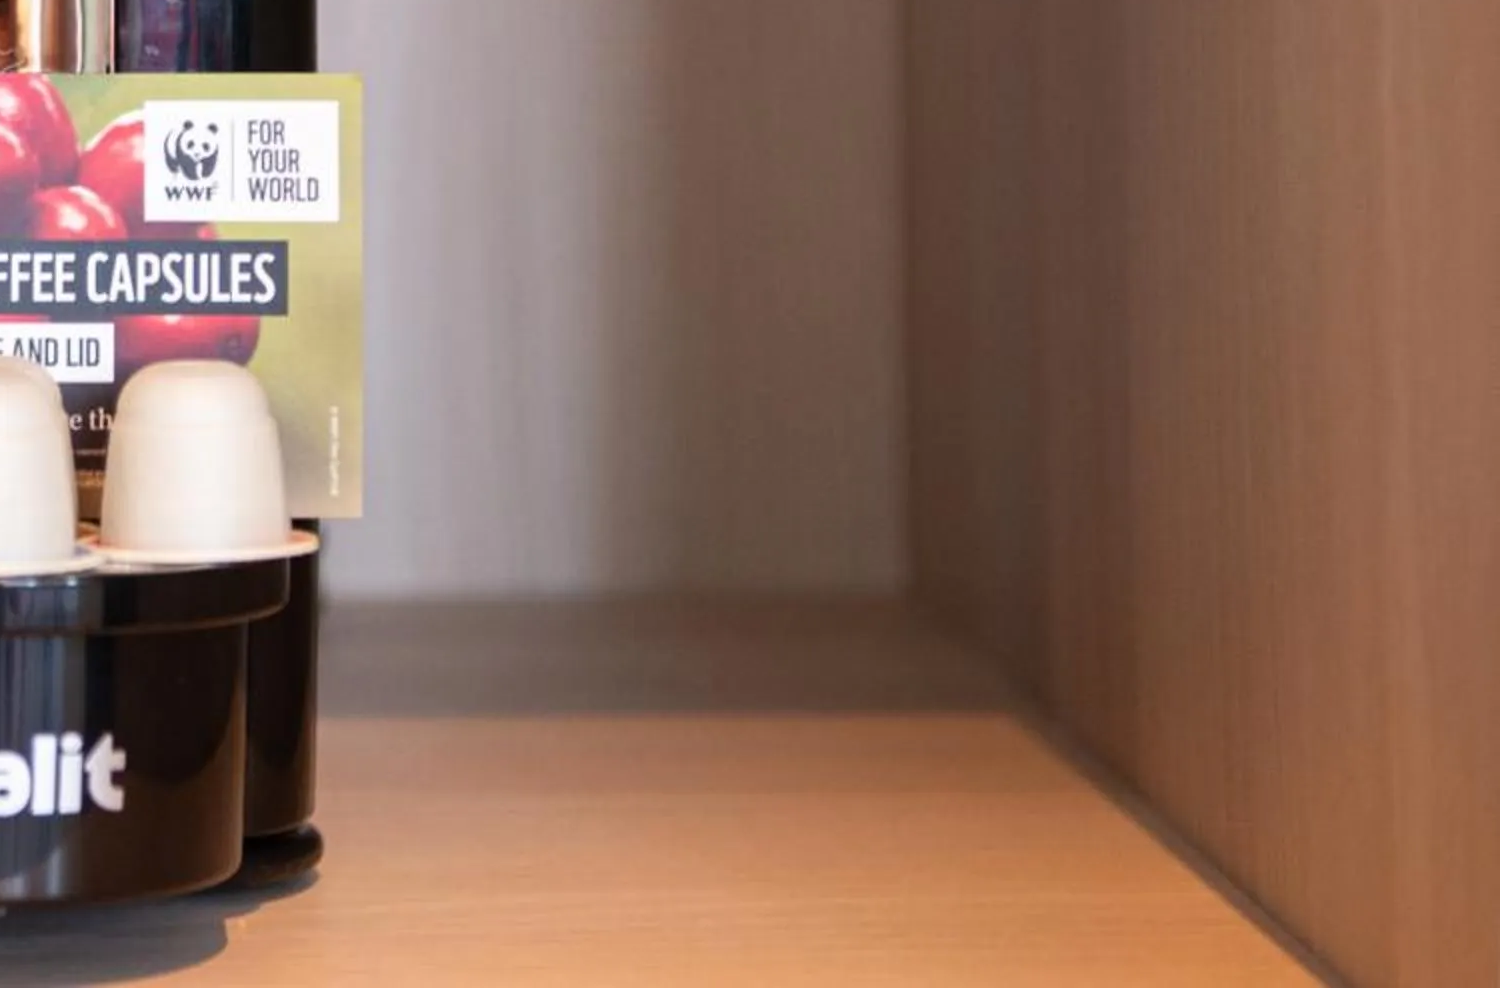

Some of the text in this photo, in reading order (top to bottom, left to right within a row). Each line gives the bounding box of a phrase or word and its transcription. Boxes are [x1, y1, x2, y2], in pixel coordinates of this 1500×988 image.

[247, 119, 285, 145] FOR
[247, 148, 300, 174] YOUR
[164, 185, 216, 202] WWF
[247, 177, 320, 203] WORLD
[86, 252, 277, 304] CAPSULES
[13, 337, 59, 368] AND
[66, 337, 101, 368] LID
